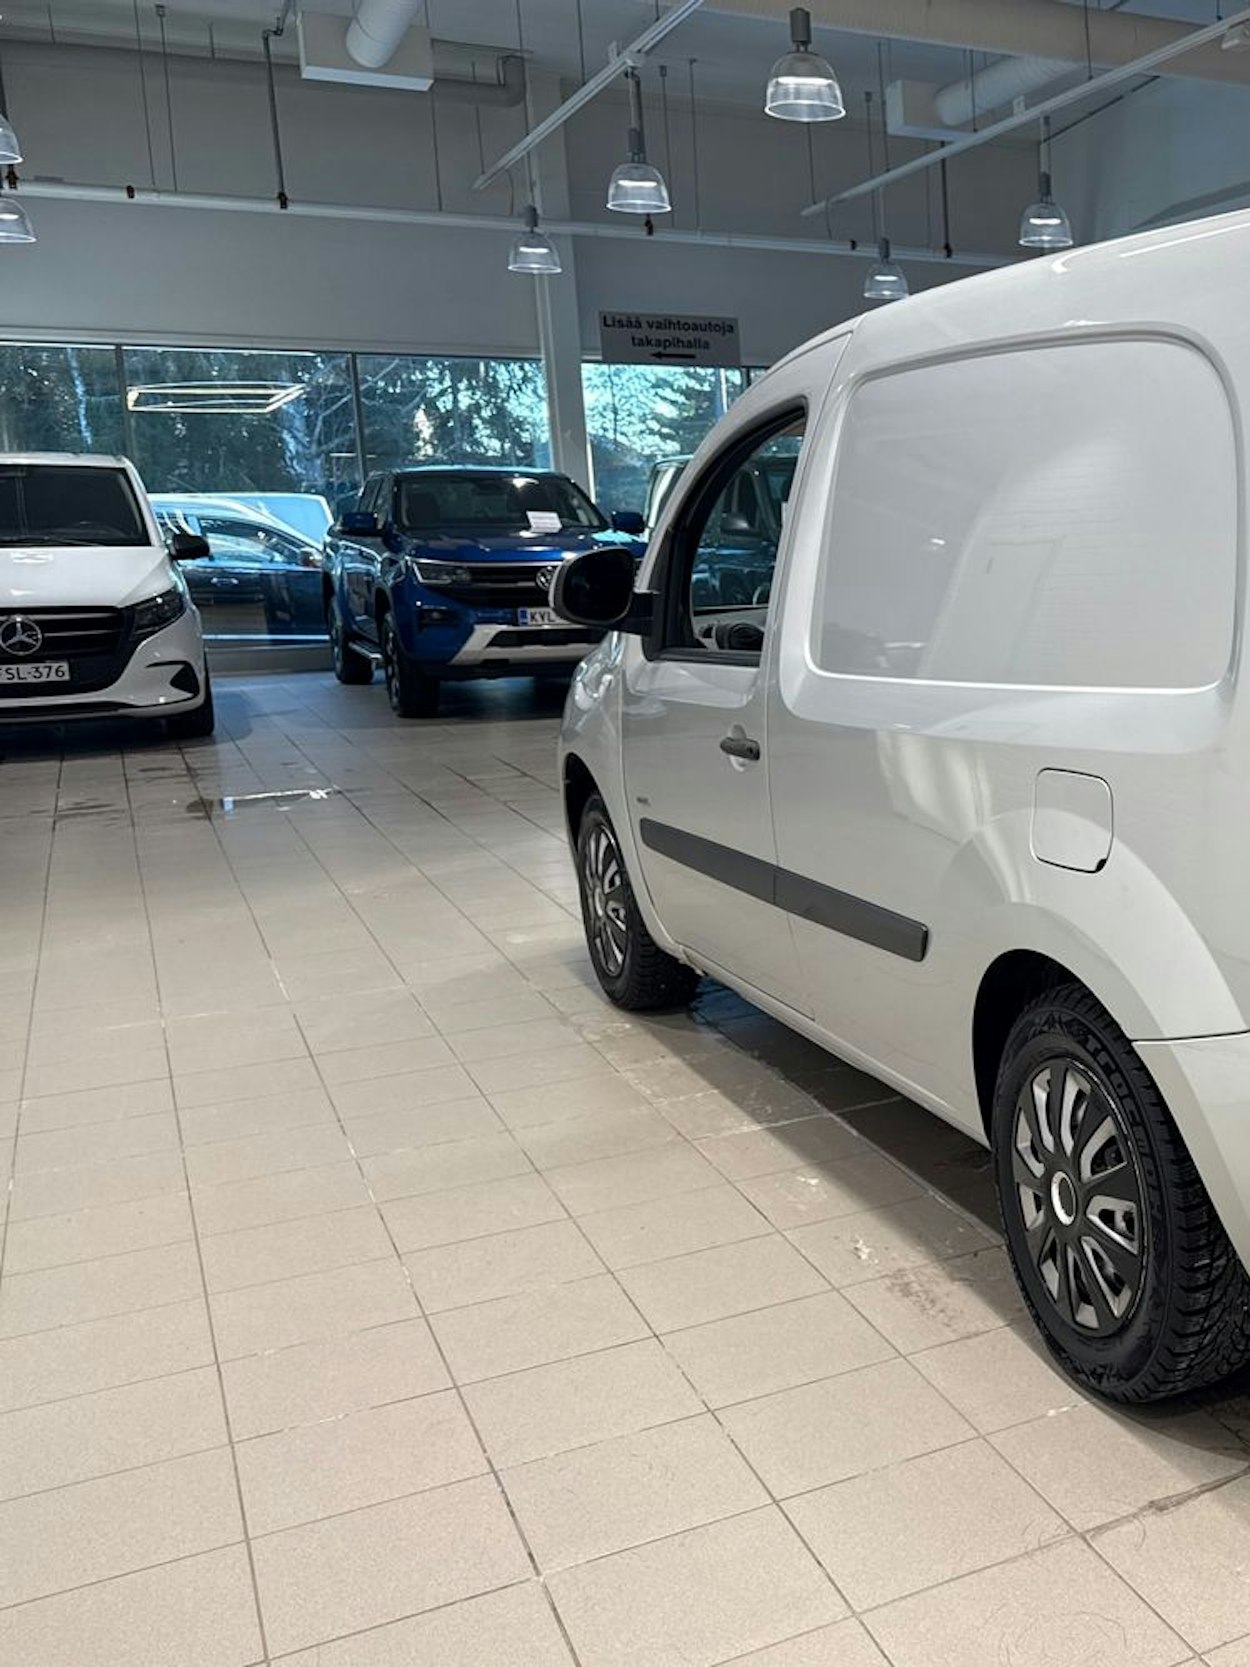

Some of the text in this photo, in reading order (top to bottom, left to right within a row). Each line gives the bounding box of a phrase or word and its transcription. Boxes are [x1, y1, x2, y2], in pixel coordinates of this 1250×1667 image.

[603, 315, 734, 336] Lisää vaihtoautoja
[631, 335, 710, 350] takapihalla
